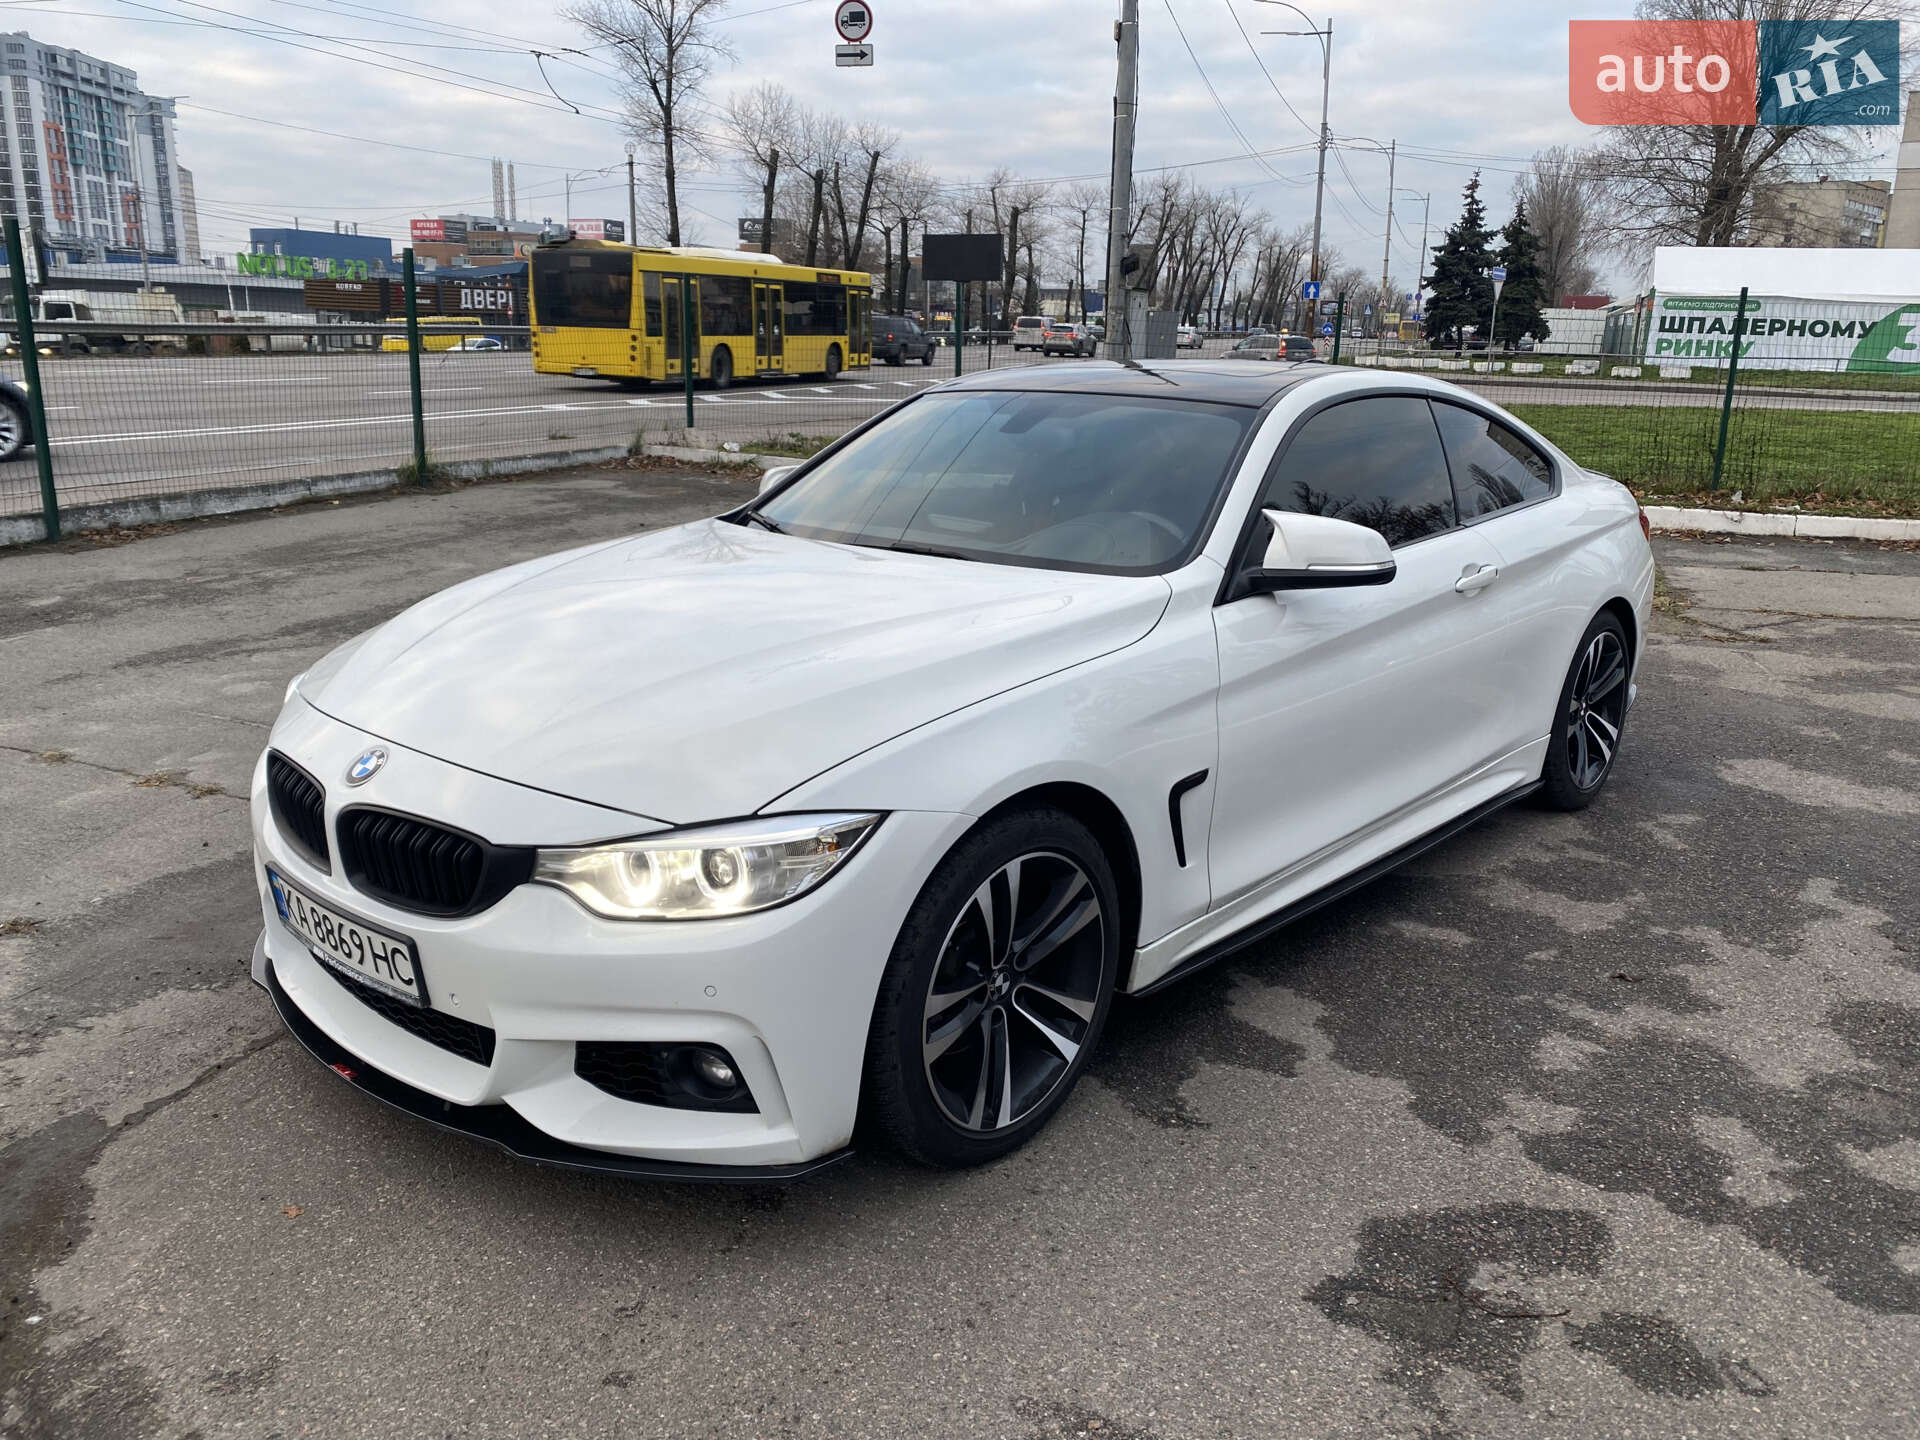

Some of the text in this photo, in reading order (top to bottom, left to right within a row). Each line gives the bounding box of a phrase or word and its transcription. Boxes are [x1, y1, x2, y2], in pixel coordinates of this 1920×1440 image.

[1658, 315, 1880, 339] ШПАЛЕРНОМУ
[1655, 337, 1755, 357] РИНКУ
[310, 906, 365, 966] 8869
